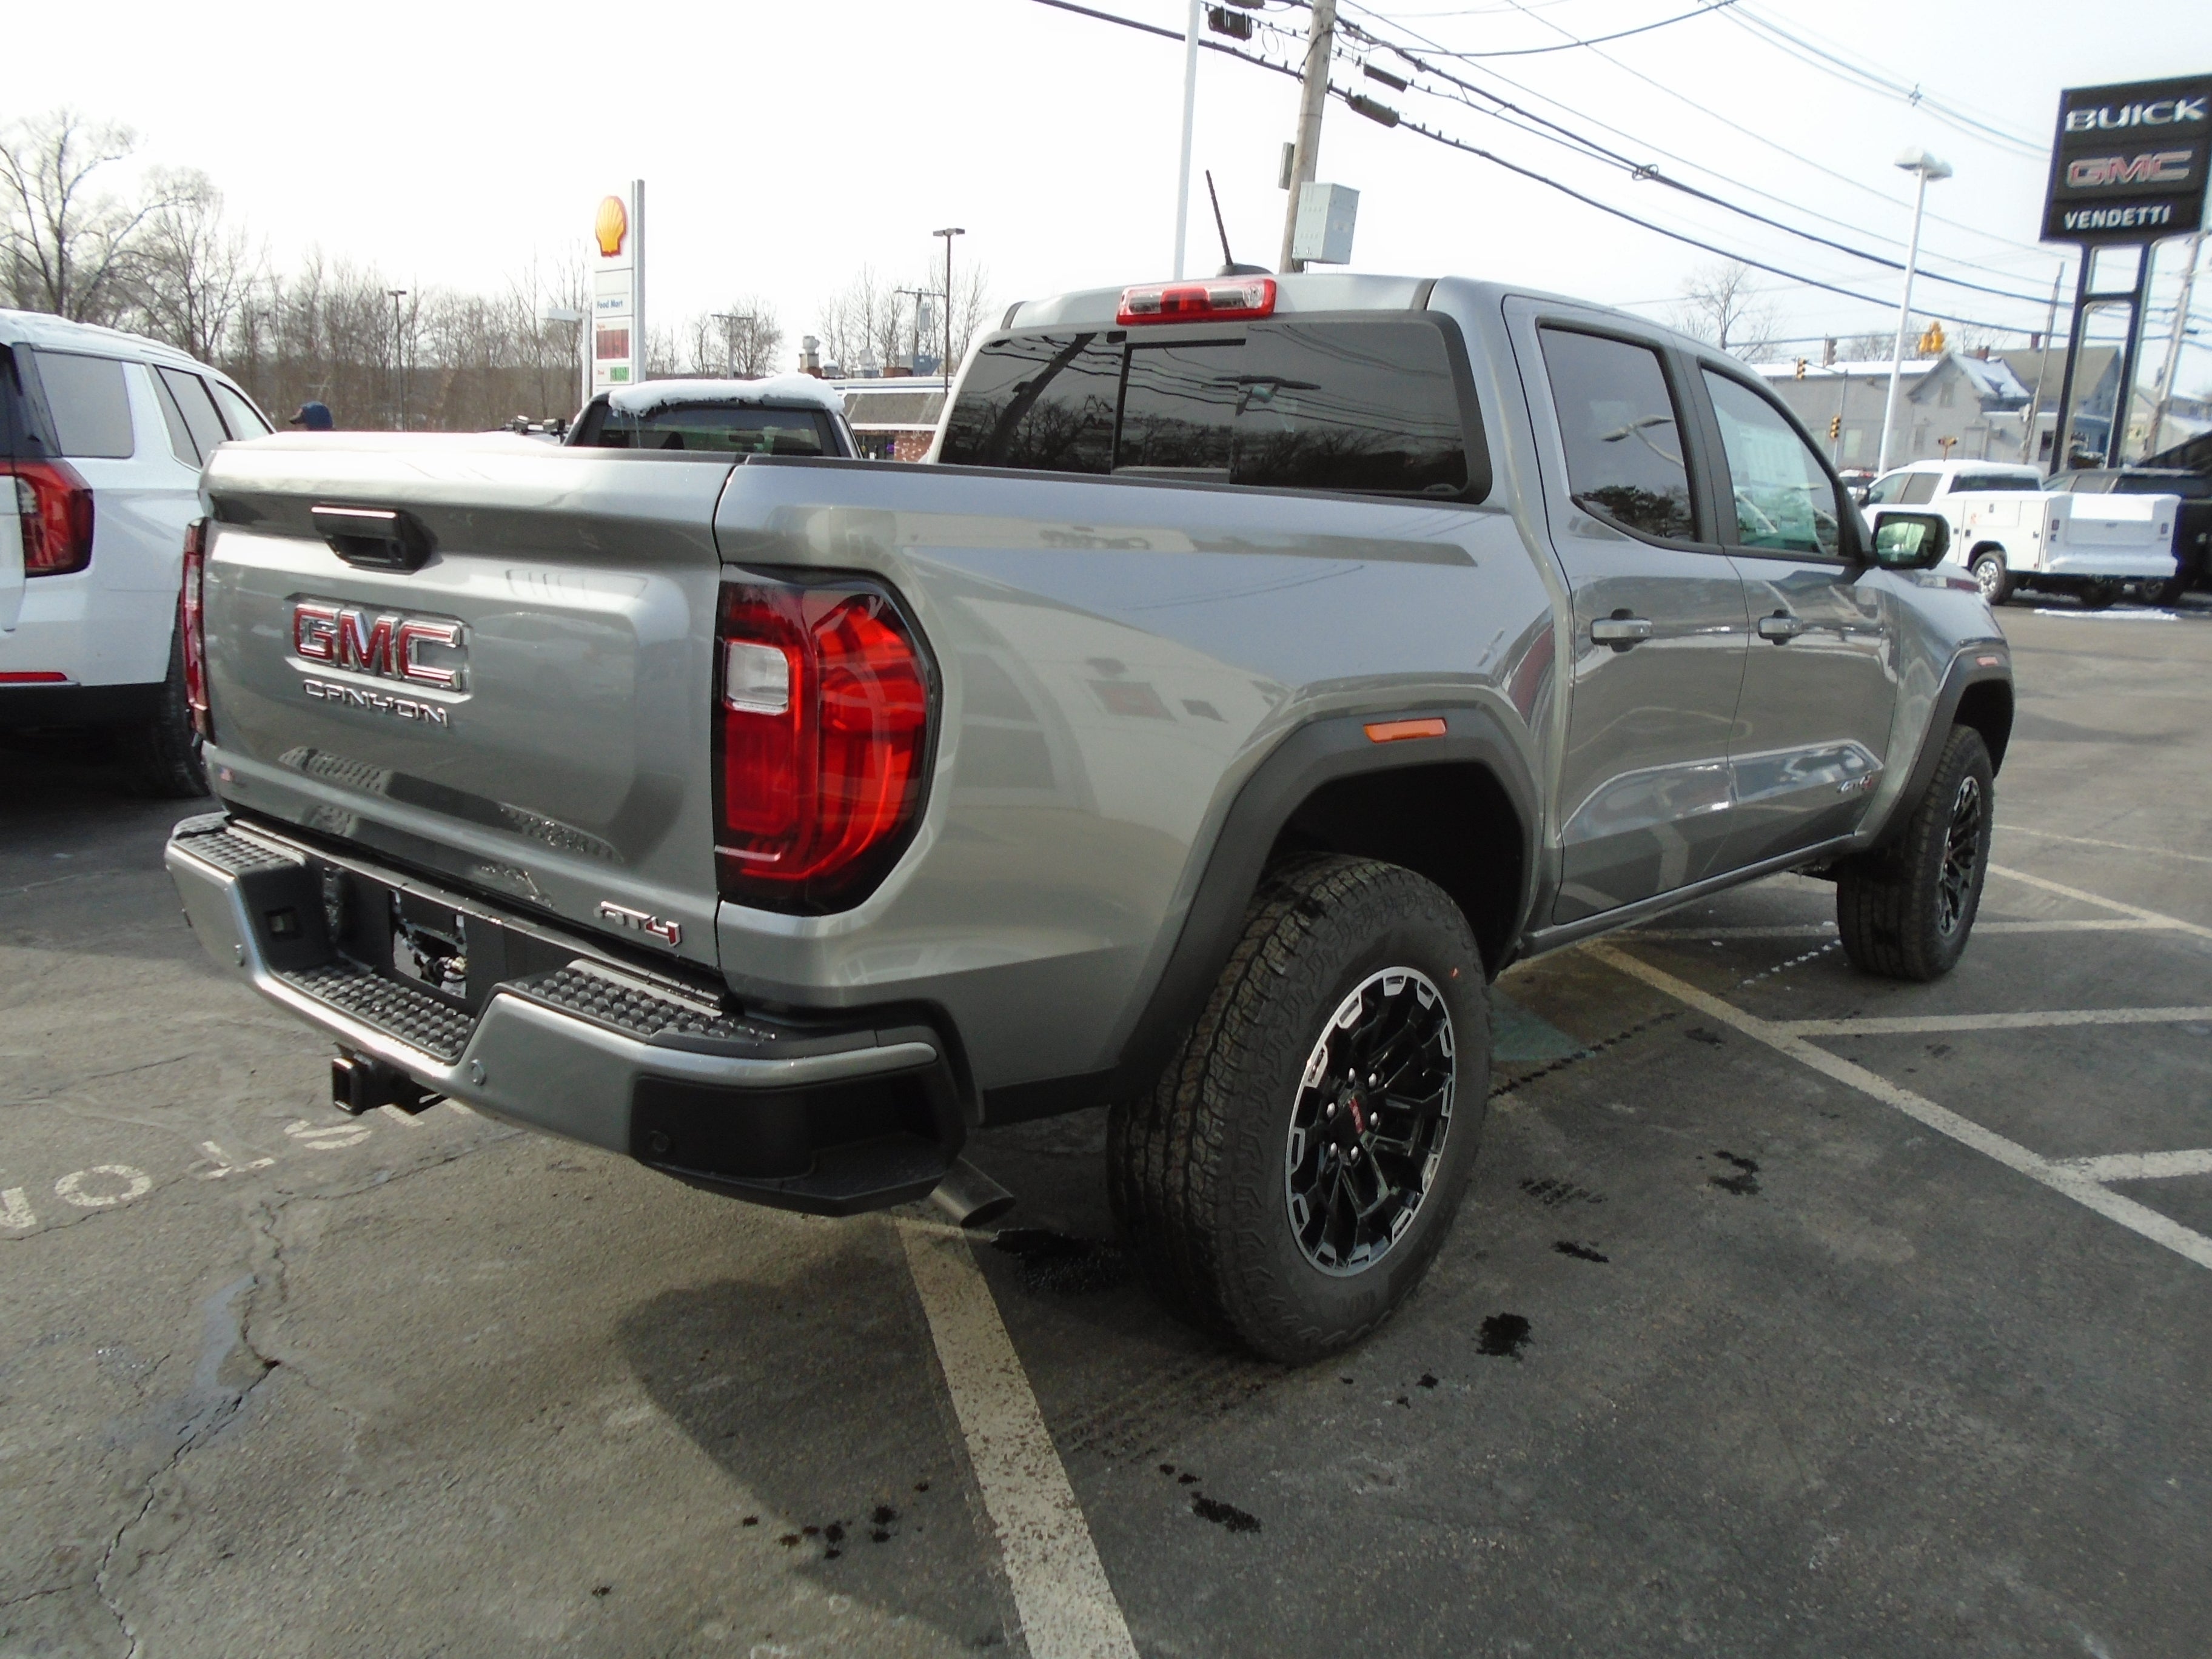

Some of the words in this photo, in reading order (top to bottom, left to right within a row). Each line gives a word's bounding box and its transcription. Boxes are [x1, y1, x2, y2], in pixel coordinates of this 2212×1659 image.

[2064, 97, 2208, 132] BUICK
[2066, 150, 2193, 188] GMC
[2063, 204, 2172, 230] VENDETTI
[597, 300, 609, 309] Food
[611, 300, 623, 308] Mart
[292, 603, 462, 691] GMC
[304, 679, 449, 728] CANYON
[594, 900, 682, 948] AT4
